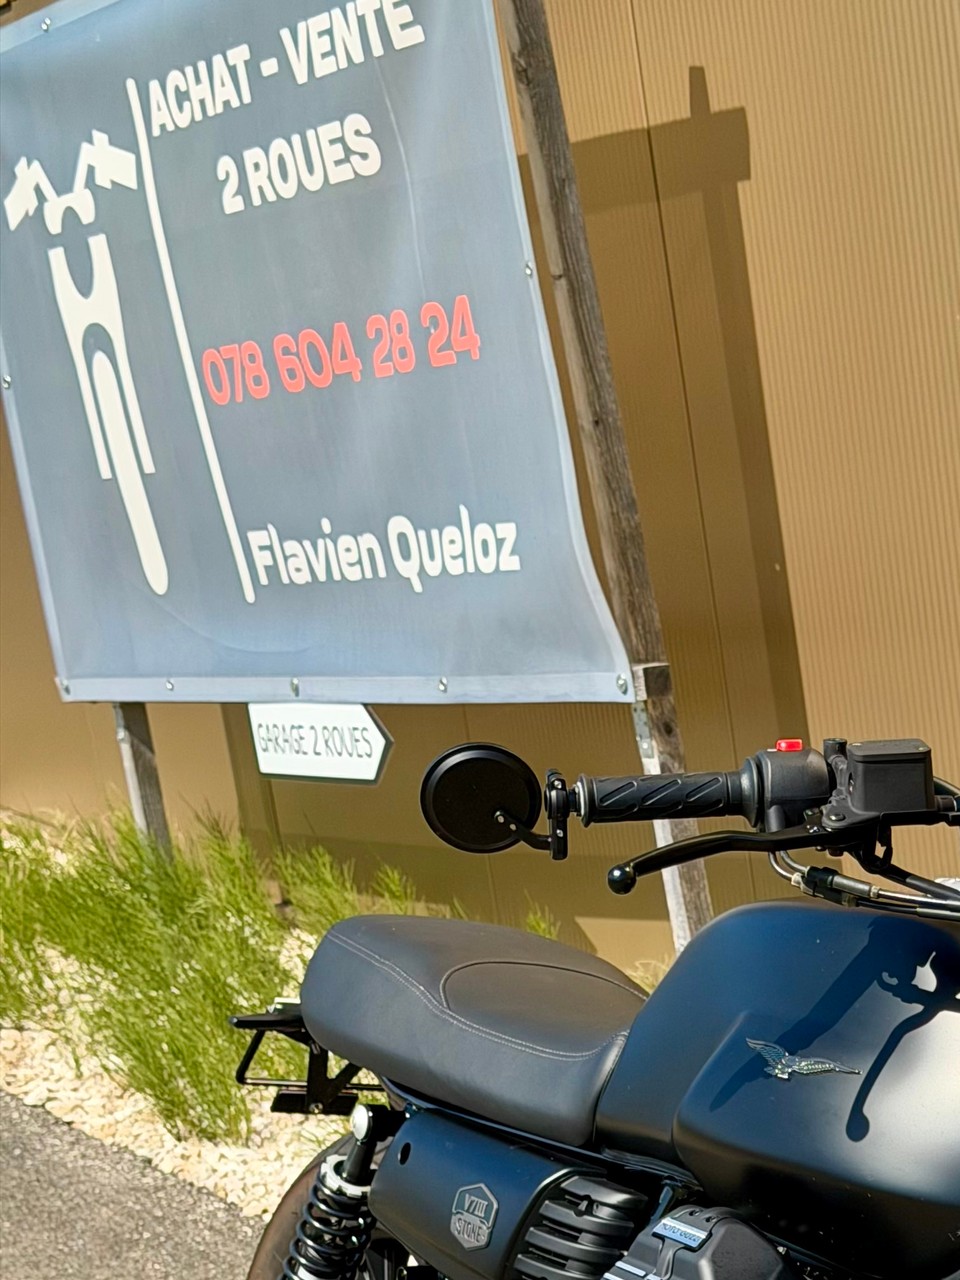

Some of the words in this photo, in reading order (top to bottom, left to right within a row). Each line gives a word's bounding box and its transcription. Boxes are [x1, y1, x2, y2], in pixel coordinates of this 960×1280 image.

[148, 43, 252, 138] ACHAT
[279, 0, 427, 85] VENTE
[216, 154, 246, 215] 2
[242, 112, 383, 207] ROUES
[202, 340, 270, 406] 078
[273, 321, 363, 393] 604
[365, 308, 416, 378] 28
[420, 294, 481, 368] 24
[246, 516, 388, 586] Flavien
[386, 503, 521, 594] Queloz
[257, 722, 308, 756] GARAGE
[308, 724, 322, 756] 2
[321, 725, 373, 759] ROUES
[455, 1217, 483, 1244] STONE
